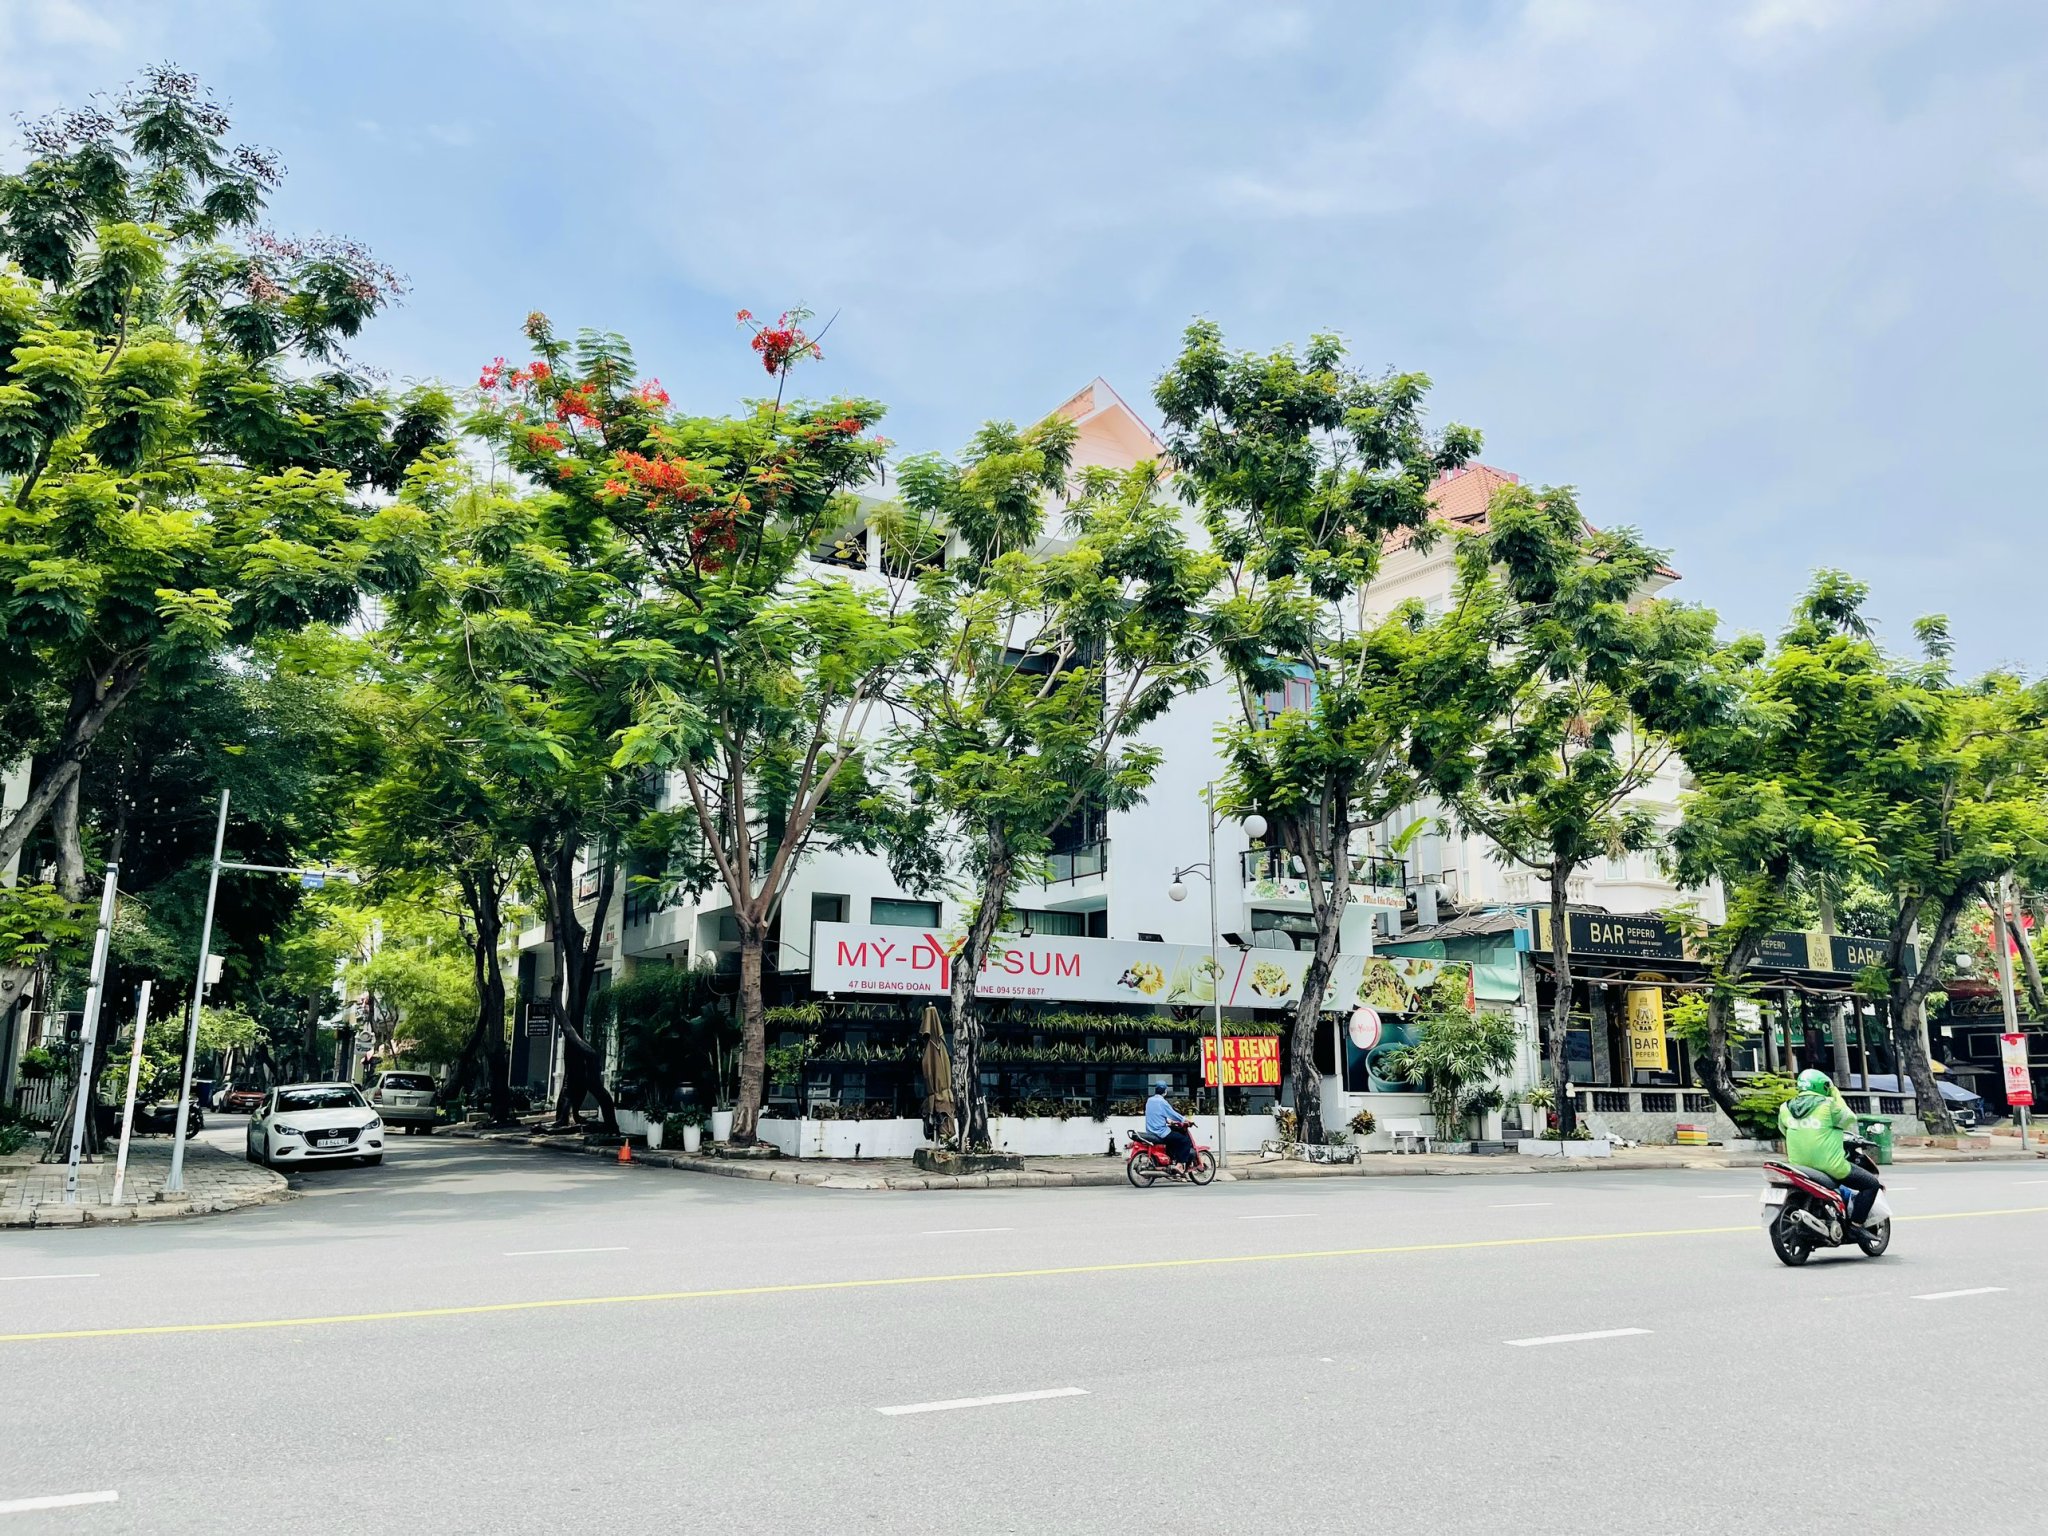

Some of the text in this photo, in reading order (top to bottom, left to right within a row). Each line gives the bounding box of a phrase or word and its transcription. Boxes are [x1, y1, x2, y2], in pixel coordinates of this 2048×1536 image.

[1590, 922, 1655, 945] BAR PEPERO
[1760, 939, 1786, 950] PEPERO
[1848, 946, 1874, 965] BAR
[848, 980, 859, 989] 47
[997, 986, 1010, 994] 094
[1012, 986, 1025, 995] 557
[1027, 987, 1045, 995] 8877
[1239, 1039, 1278, 1058] RENT
[1634, 1038, 1659, 1050] BAR
[1238, 1059, 1259, 1084] 355
